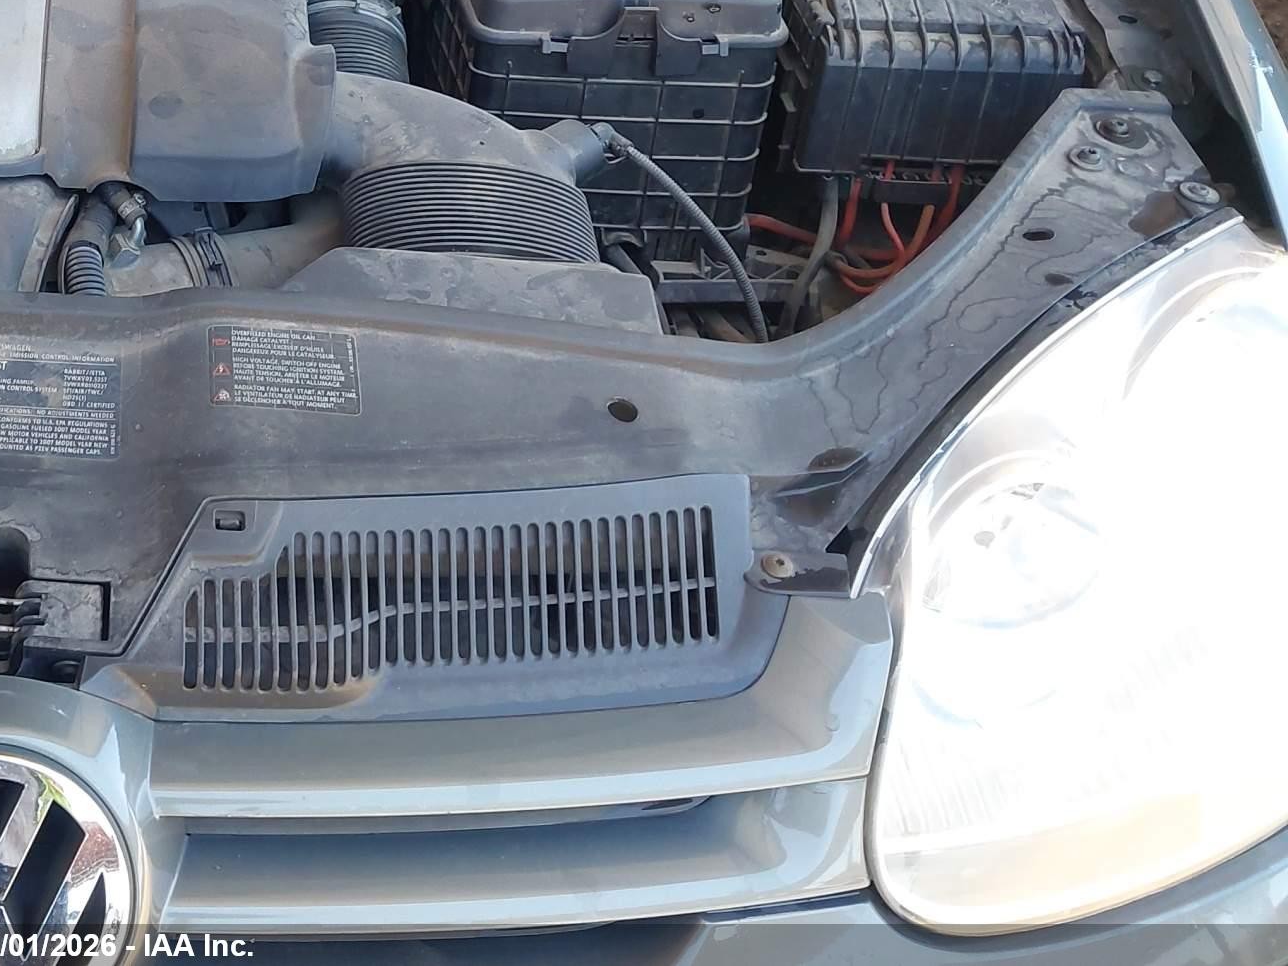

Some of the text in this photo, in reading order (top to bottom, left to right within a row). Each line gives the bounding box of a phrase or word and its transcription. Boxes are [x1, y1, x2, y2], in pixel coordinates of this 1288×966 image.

[231, 330, 266, 338] OVERFILLED
[267, 331, 290, 339] ENGINE
[231, 341, 272, 350] REMPLISSAGE
[232, 347, 269, 355] DANGEREUX
[41, 353, 70, 361] CONTROL
[71, 355, 115, 363] INFORMATION
[232, 356, 249, 364] HIGH
[280, 359, 305, 367] SWITCH
[233, 362, 255, 370] BEFORE
[255, 364, 289, 373] TOUCHING
[289, 365, 318, 374] IGNITION
[234, 374, 255, 382] AVANT
[265, 376, 295, 384] TOUCHER
[318, 374, 345, 382] MOTEUR
[6, 384, 34, 392] CONTROL
[34, 386, 58, 394] SYSTEM
[234, 384, 265, 392] RADIATOR
[266, 385, 280, 393] FAN
[280, 387, 296, 395] MAY
[296, 388, 316, 396] START
[242, 391, 284, 400] VENTILATEUR
[293, 394, 329, 403] RADIATEUR
[329, 395, 346, 403] PEUT
[47, 410, 89, 418] ADJUSTMENTS
[0, 422, 30, 431] GASOLINE
[69, 427, 91, 435] MODEL
[91, 428, 108, 436] YEAR
[67, 420, 109, 429] REGULATIONS
[7, 430, 30, 438] MOTOR
[30, 431, 58, 440] VEHICLES
[73, 434, 110, 442] CALIFORNIA
[54, 440, 76, 448] MODEL
[50, 446, 84, 454] PASSENGER
